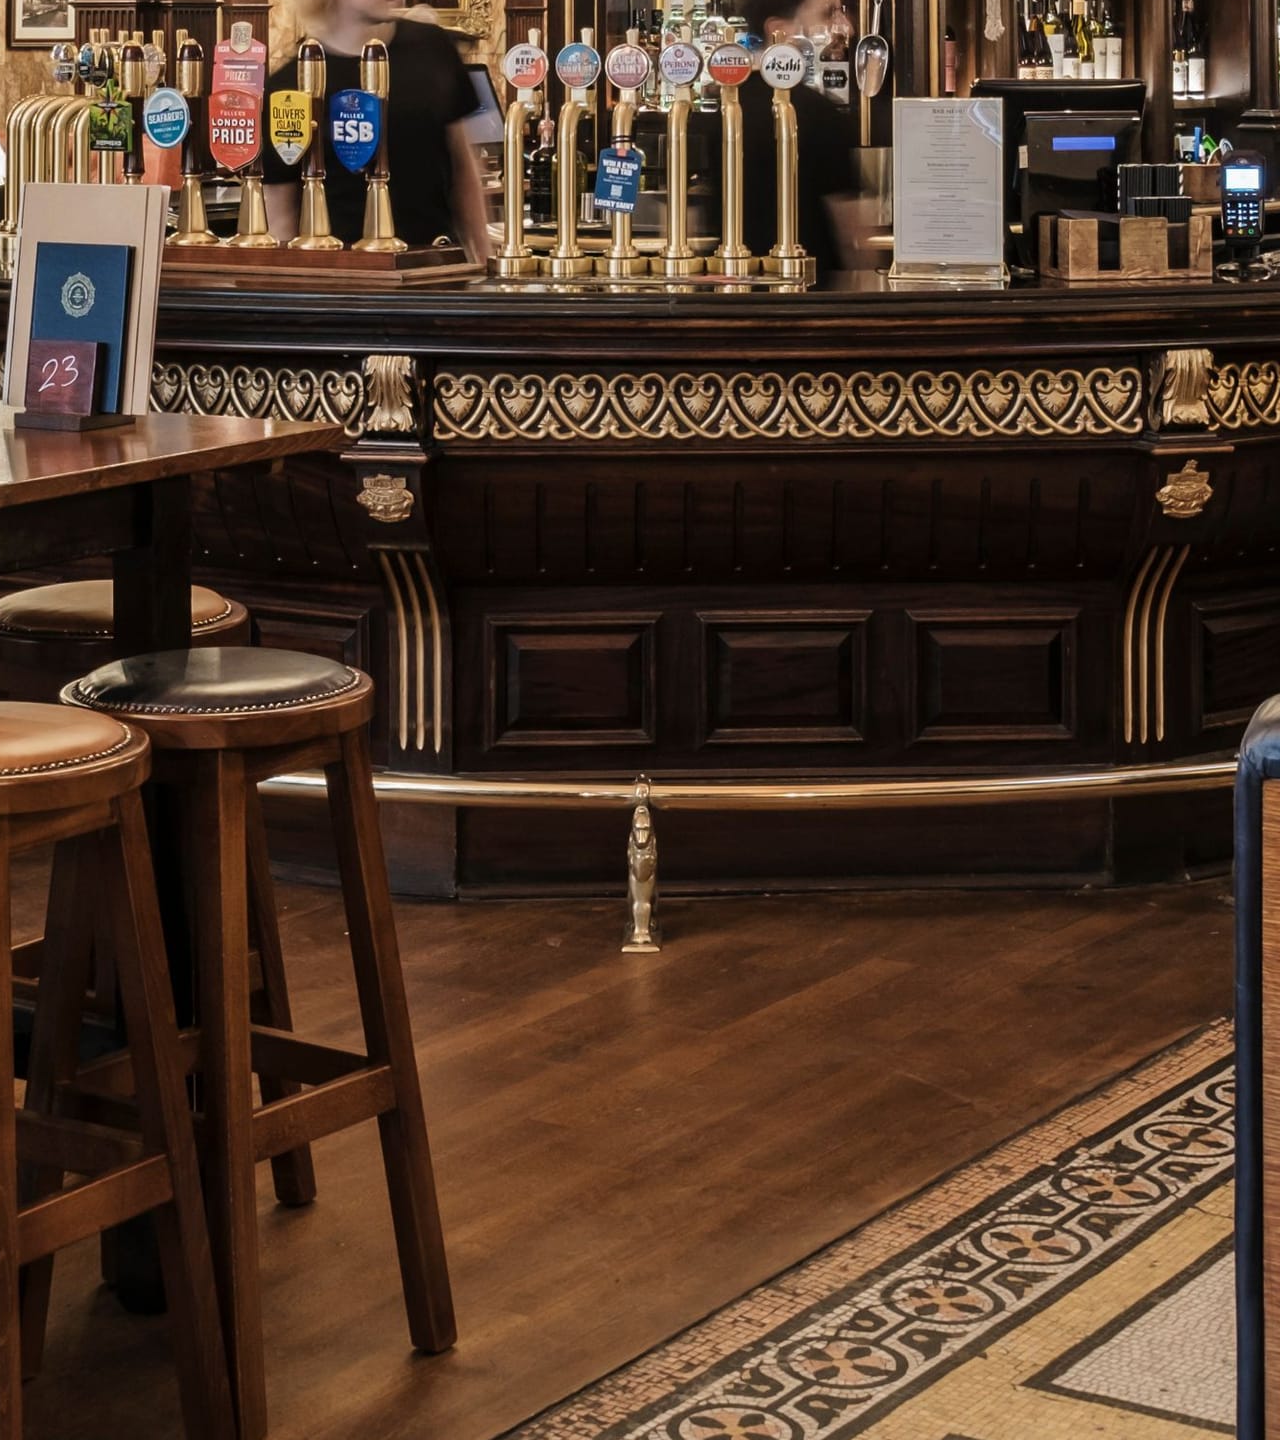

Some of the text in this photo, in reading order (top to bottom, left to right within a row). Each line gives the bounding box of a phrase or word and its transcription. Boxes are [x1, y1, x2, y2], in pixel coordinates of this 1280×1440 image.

[614, 55, 642, 64] LUCKY
[664, 60, 696, 69] PERONI
[712, 56, 748, 65] AMSTEL
[765, 57, 801, 72] Asahi
[612, 64, 643, 74] SAINT
[148, 111, 184, 124] SEAFARERS
[273, 107, 305, 119] OLIVER'S
[212, 118, 255, 126] LONDON
[277, 119, 302, 131] ISLAND
[212, 128, 255, 144] PRIDE
[333, 120, 374, 143] ESB
[594, 198, 634, 210] LUCKY SAINT
[38, 355, 79, 393] 23
